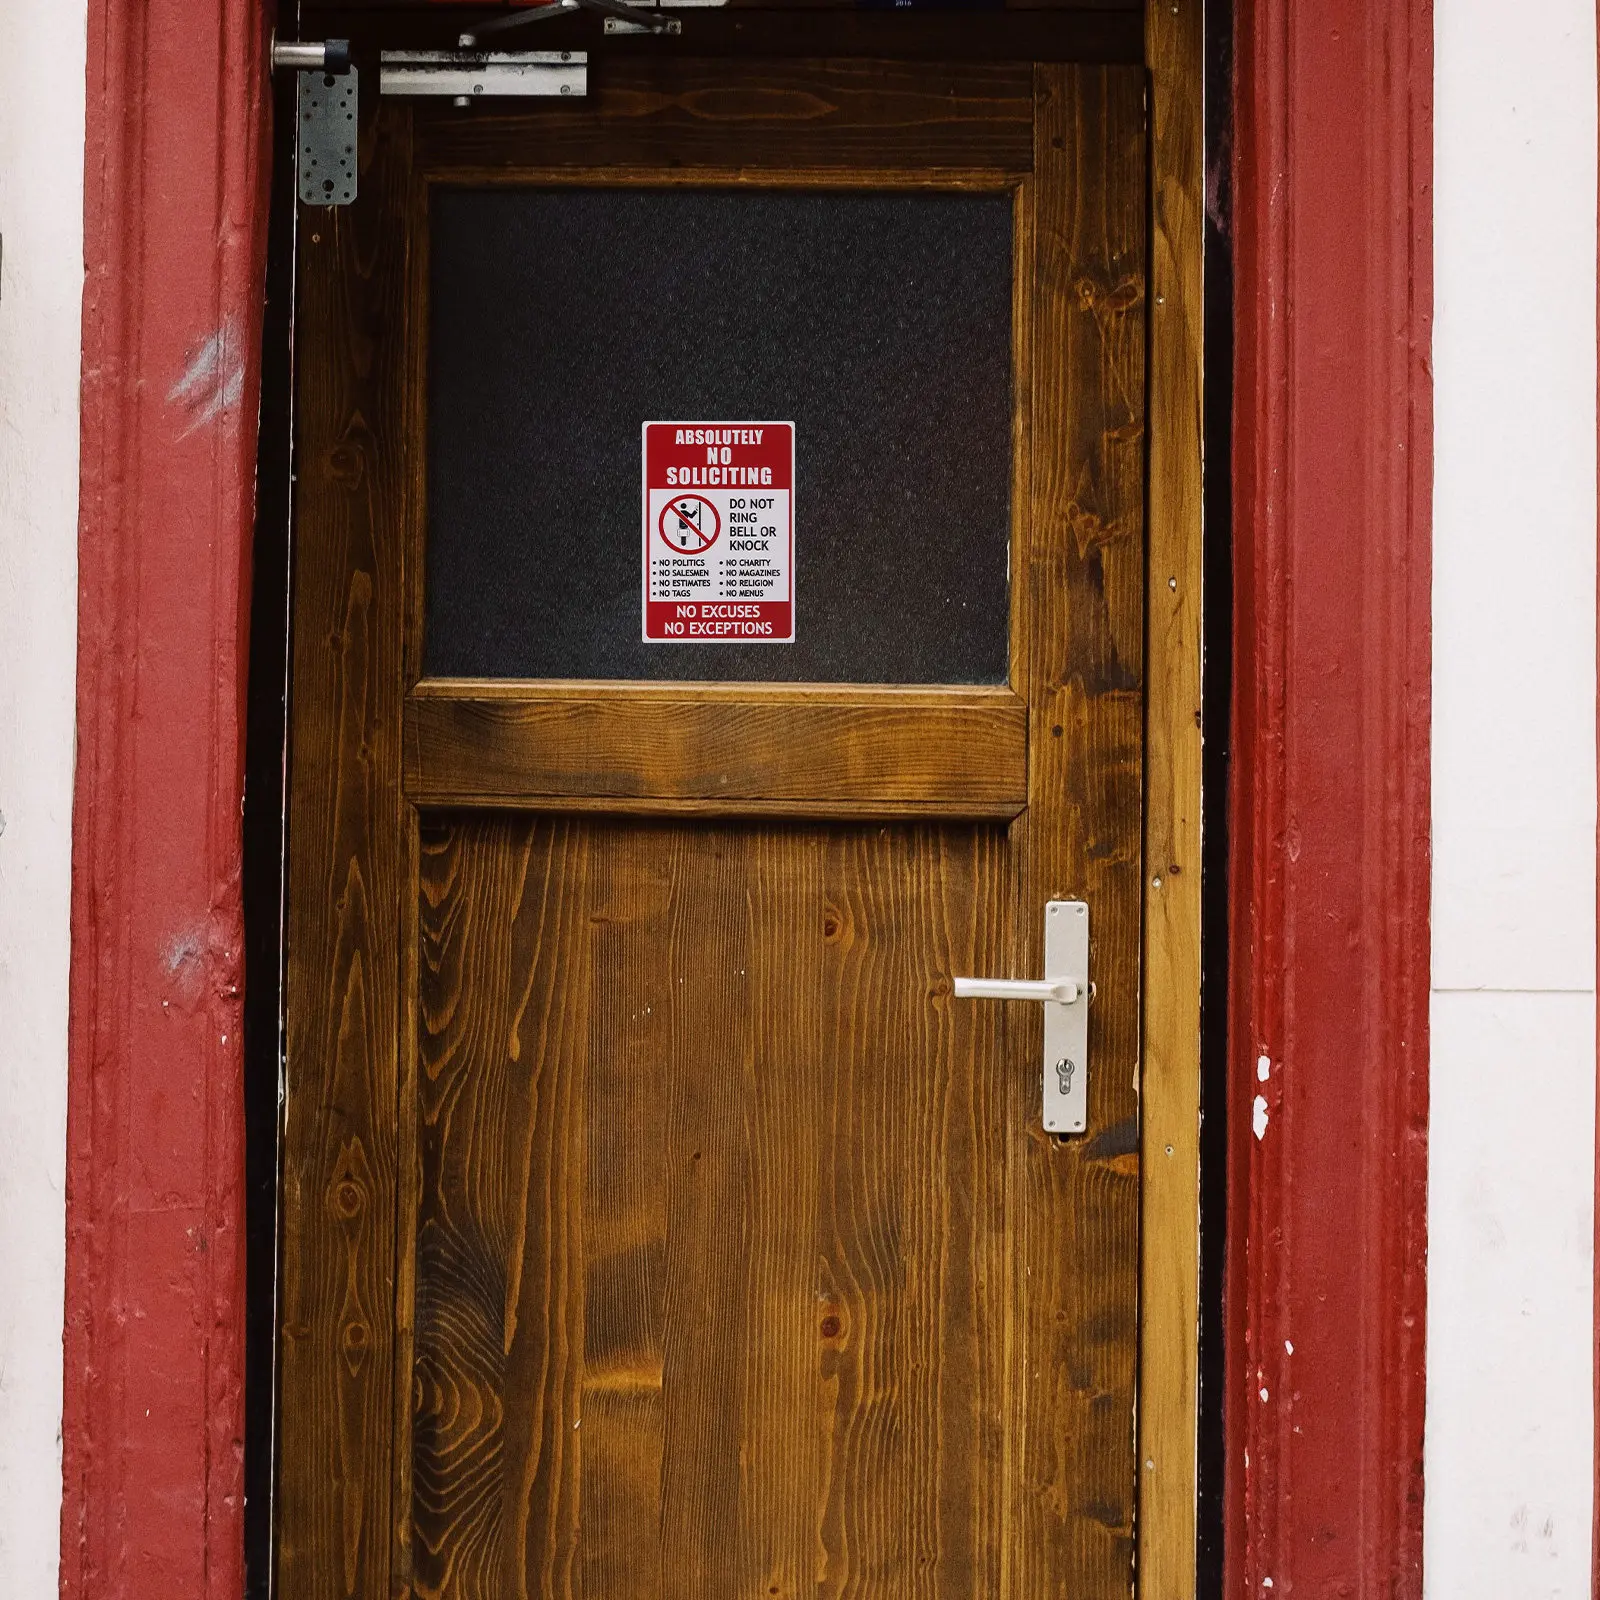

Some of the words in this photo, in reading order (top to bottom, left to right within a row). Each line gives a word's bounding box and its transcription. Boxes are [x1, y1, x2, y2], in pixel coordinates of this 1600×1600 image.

[676, 430, 763, 445] ABSOLUTELY
[707, 447, 731, 465] NO
[667, 467, 772, 485] SOLICITING
[730, 499, 745, 509] DO
[750, 499, 774, 509] NOT
[730, 513, 757, 523] RING
[730, 527, 756, 537] BELL
[761, 527, 776, 537] OR
[730, 541, 768, 551] KNOCK
[677, 605, 696, 618] NO
[702, 605, 760, 618] EXCUSES
[665, 622, 684, 635] NO
[690, 622, 772, 635] EXCEPTIONS
